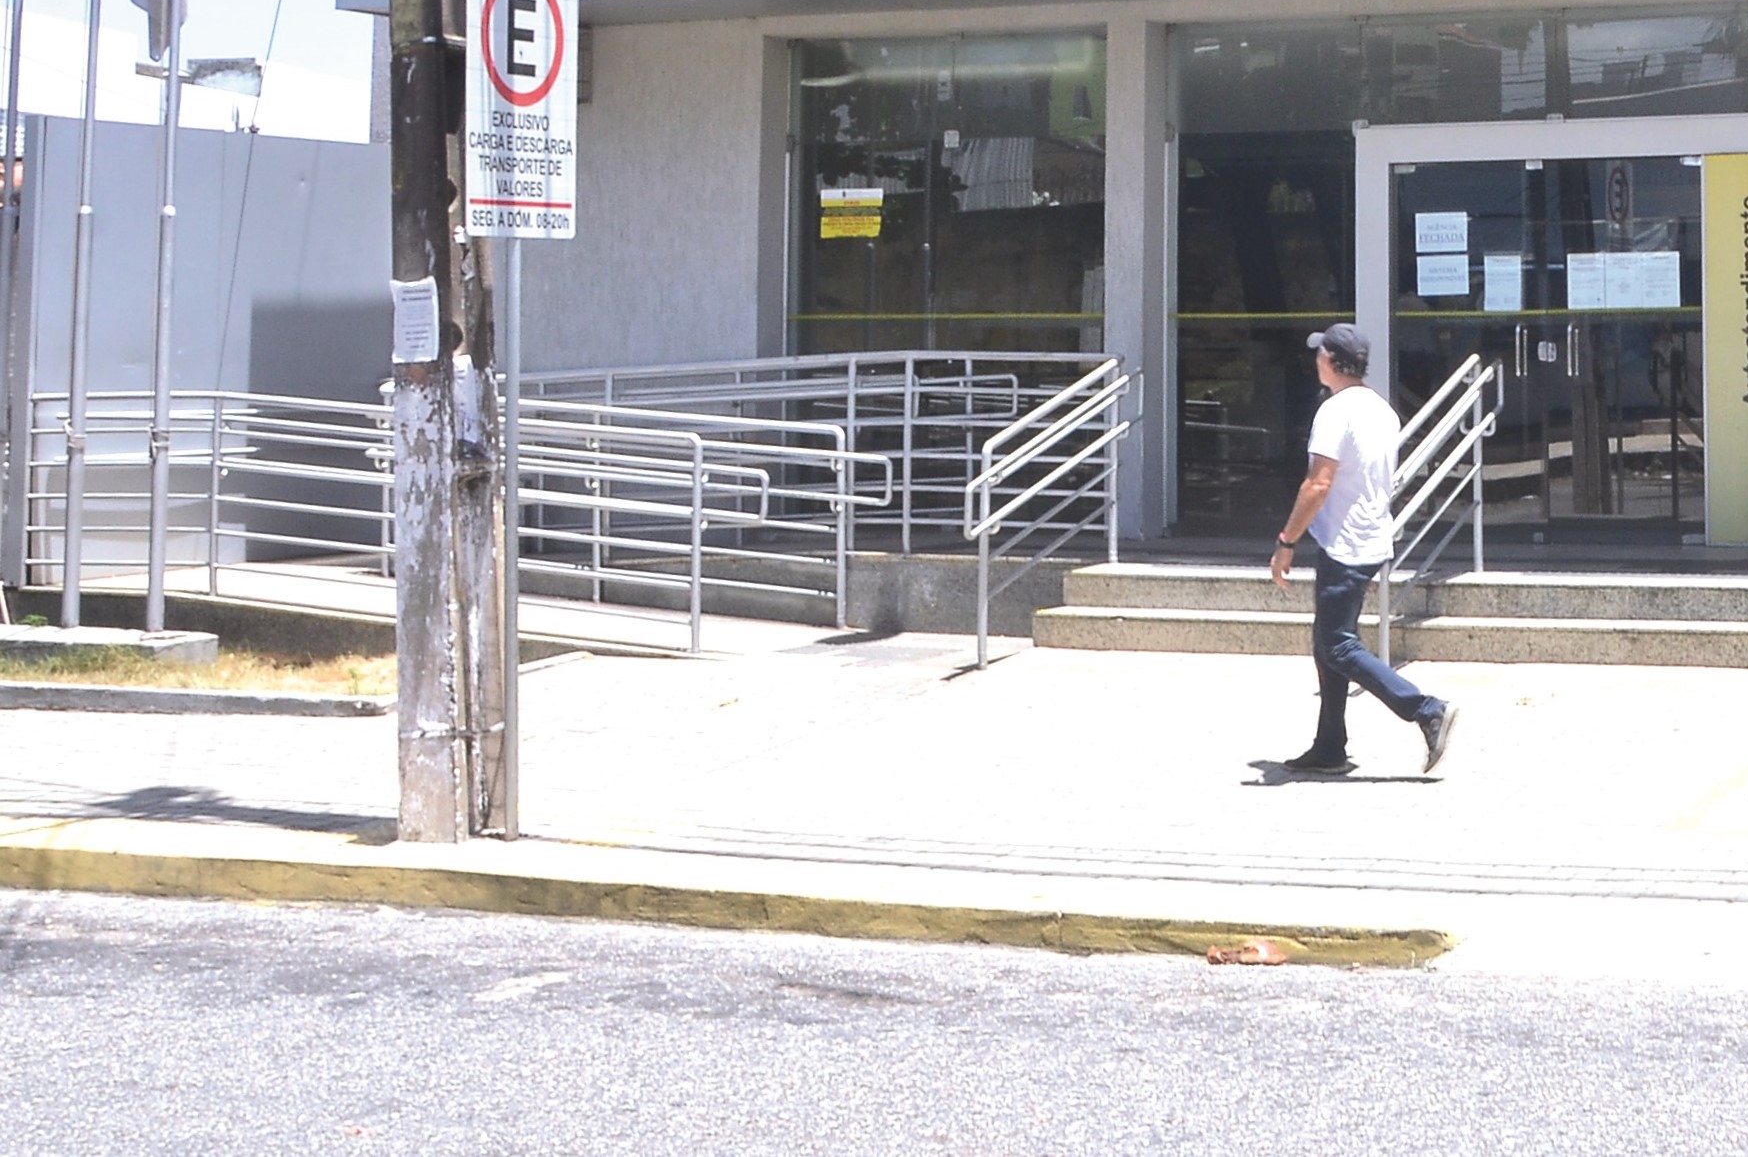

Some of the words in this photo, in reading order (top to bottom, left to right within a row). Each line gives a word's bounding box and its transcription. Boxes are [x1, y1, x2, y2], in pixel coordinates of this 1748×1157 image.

[493, 111, 549, 131] EXCLUSIVO
[469, 132, 505, 151] CARGA
[507, 135, 513, 152] E
[516, 136, 573, 155] DESCARGA
[479, 155, 546, 176] TRANSPORTE
[548, 160, 562, 176] DE
[496, 179, 543, 197] VALORES
[472, 210, 495, 227] SEG.
[498, 211, 505, 227] A
